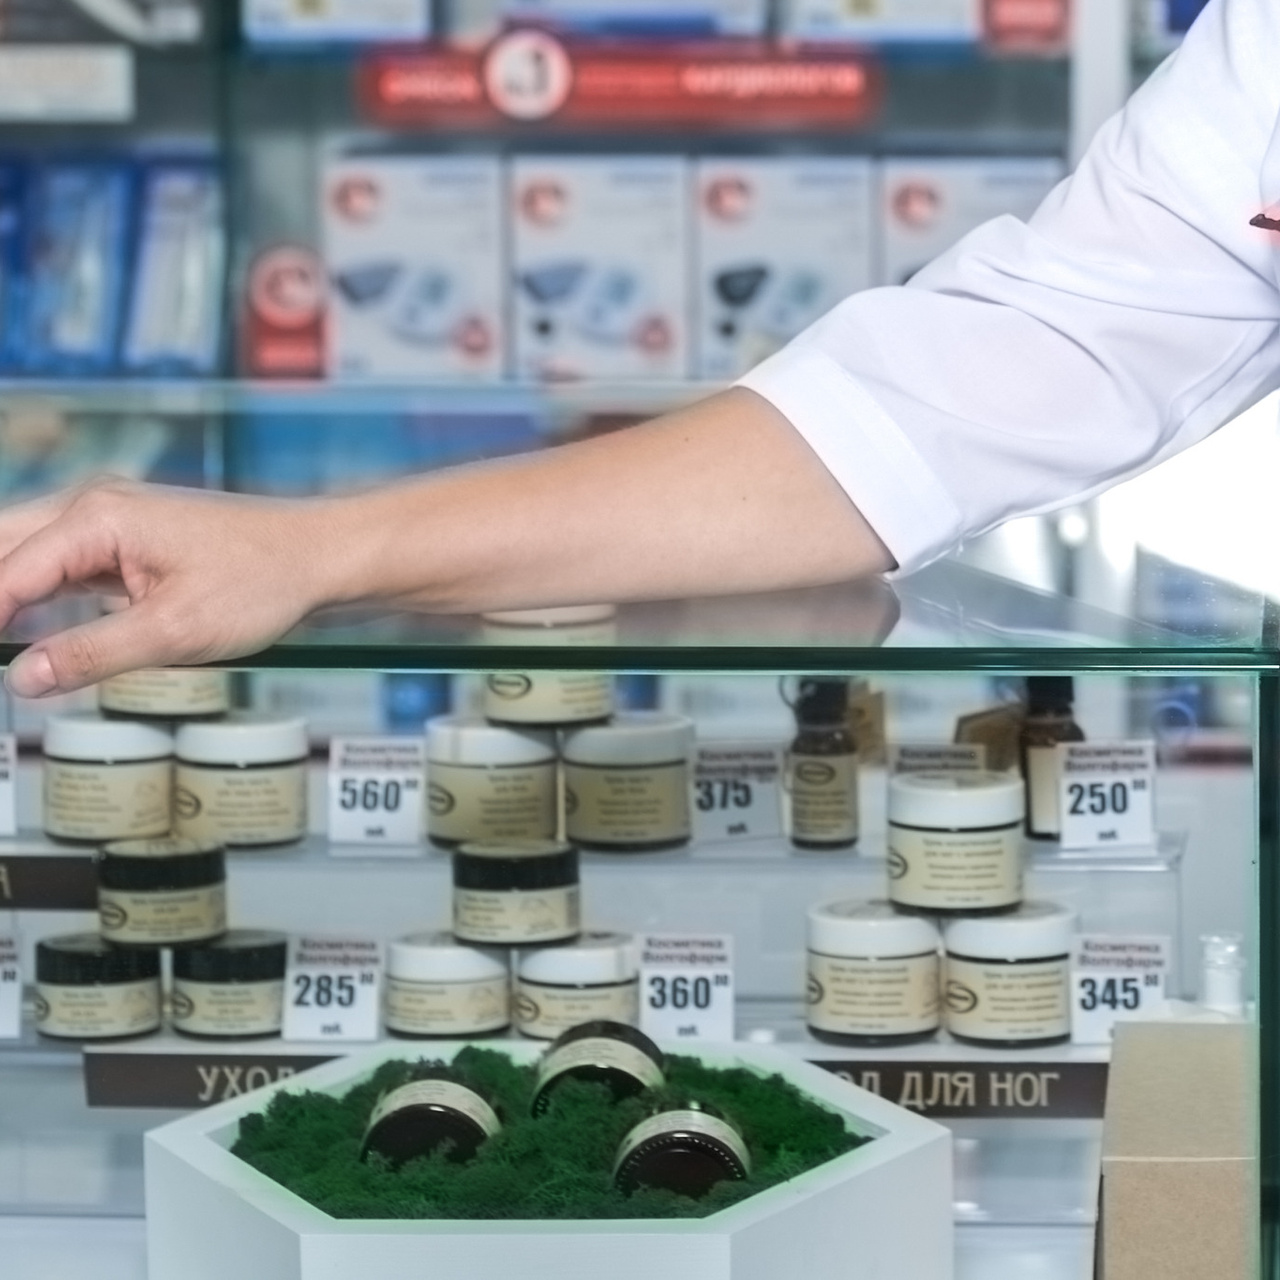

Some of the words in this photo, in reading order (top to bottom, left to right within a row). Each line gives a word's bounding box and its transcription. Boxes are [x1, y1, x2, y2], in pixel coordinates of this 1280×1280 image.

[340, 778, 401, 812] 560
[696, 780, 753, 812] 375
[1067, 782, 1128, 815] 250
[294, 975, 355, 1008] 285
[649, 976, 711, 1009] 360
[1080, 977, 1140, 1011] 345
[899, 1070, 976, 1110] ДЛЯ
[988, 1071, 1060, 1108] НОГ
